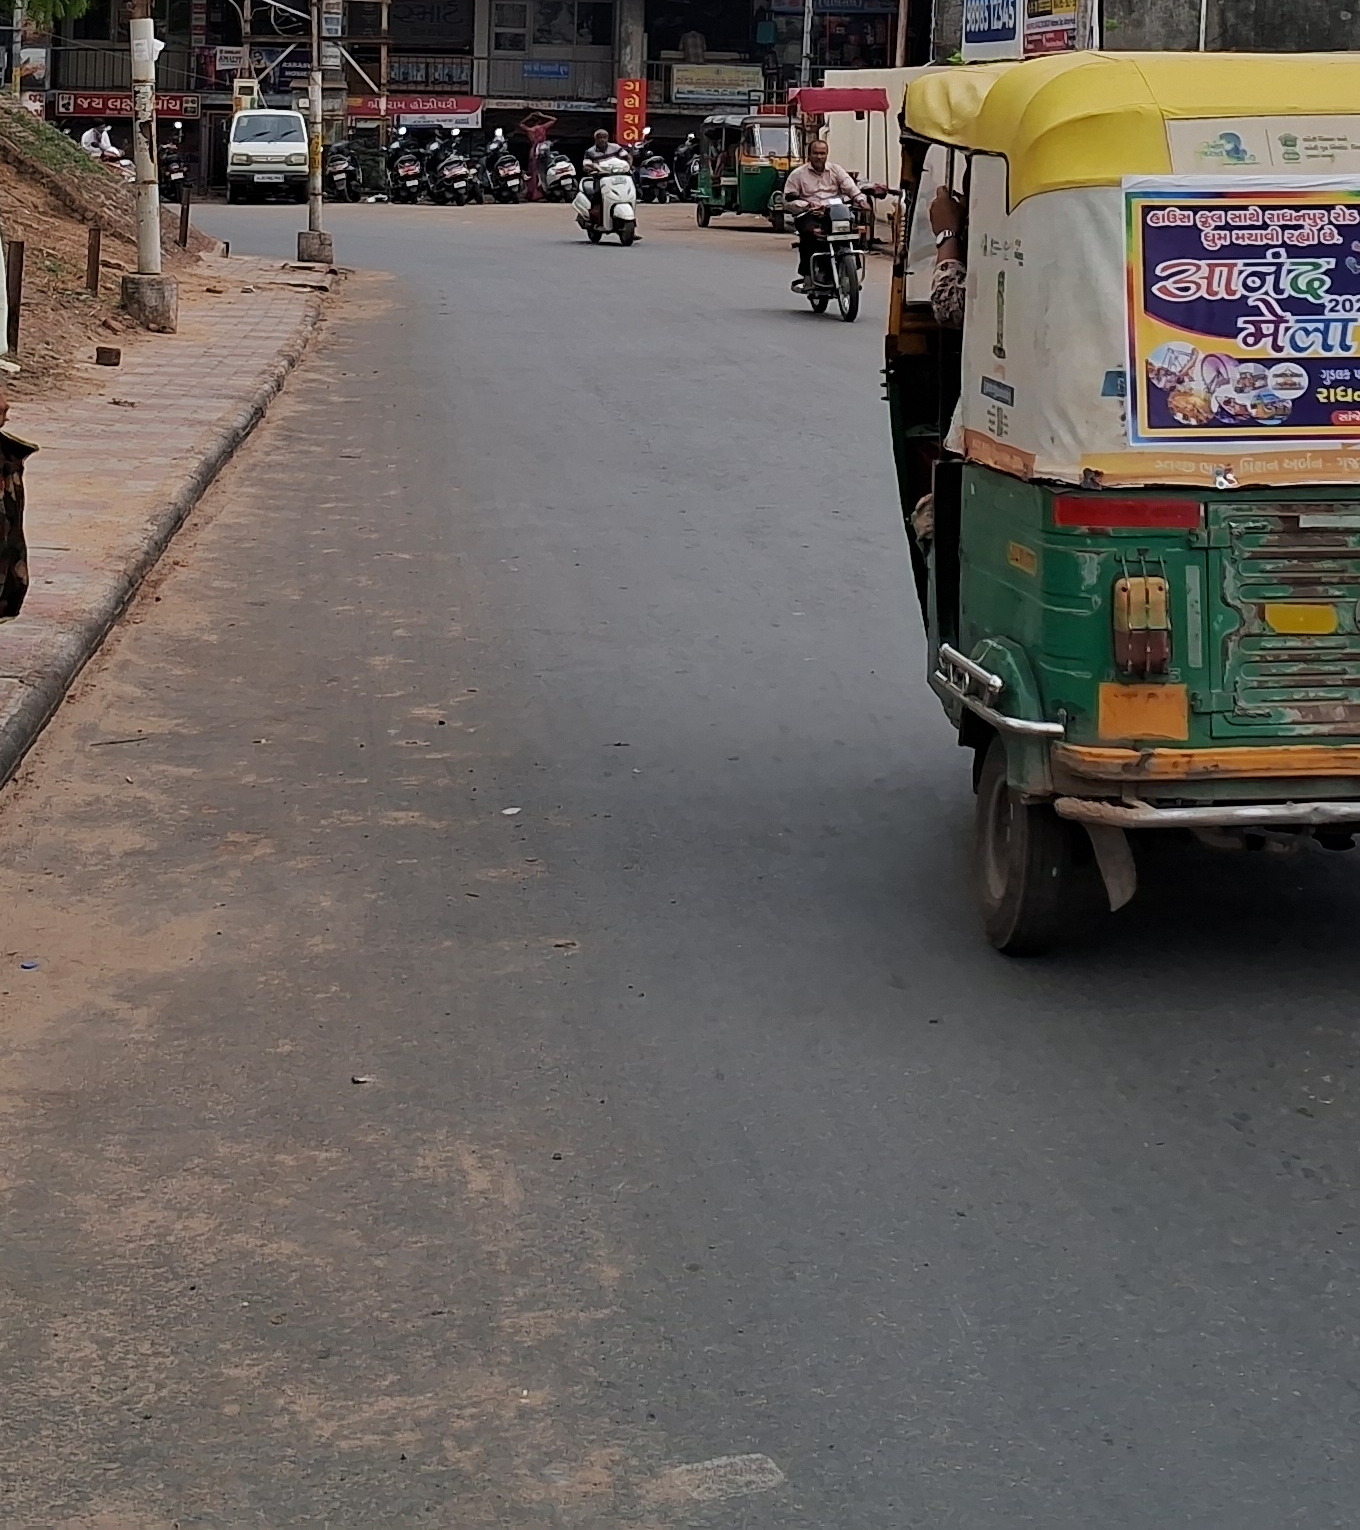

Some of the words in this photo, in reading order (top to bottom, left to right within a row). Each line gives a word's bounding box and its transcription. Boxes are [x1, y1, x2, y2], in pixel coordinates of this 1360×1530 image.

[76, 97, 103, 109] જય
[387, 100, 406, 110] રામ
[1148, 209, 1192, 225] હાઉસ
[1228, 208, 1261, 224] સાથે
[1266, 211, 1327, 228] રાધનપુર
[1332, 206, 1359, 223] રોડ
[1233, 227, 1280, 244] મચાવી
[1321, 227, 1343, 244] છે.
[1153, 252, 1334, 299] आनंद
[1241, 299, 1359, 353] मेला
[1320, 369, 1351, 385] ગુડલક
